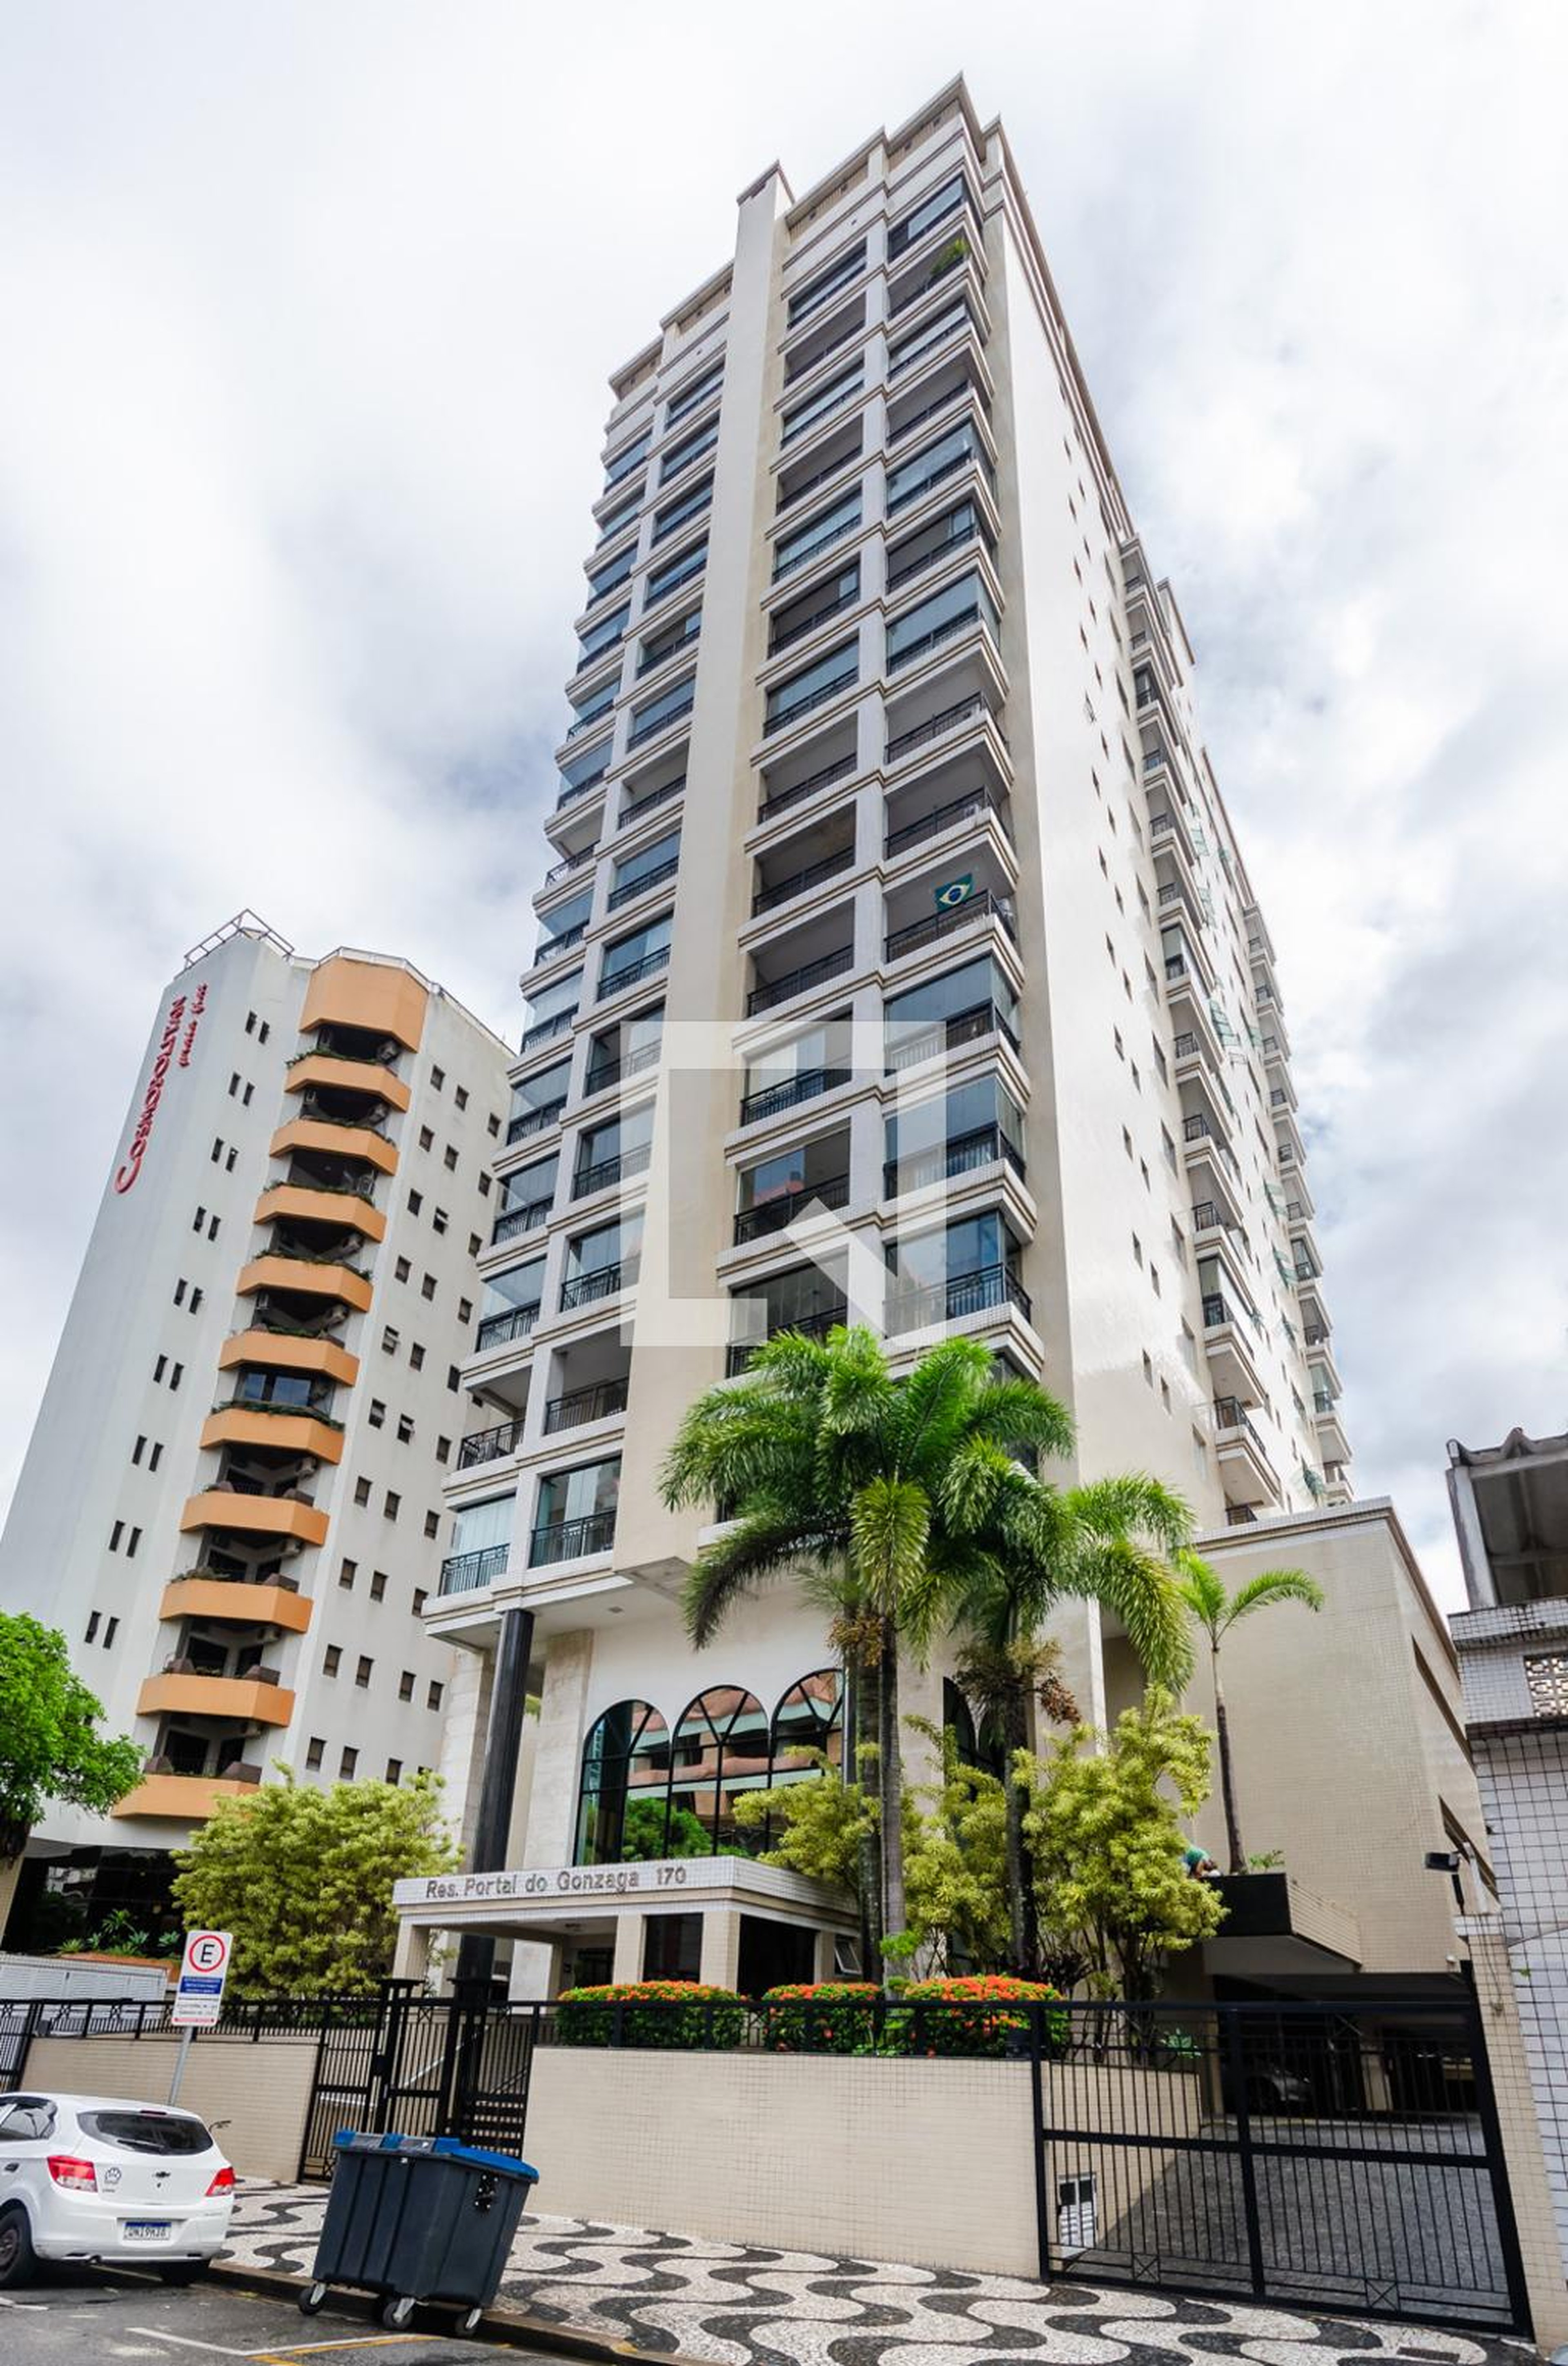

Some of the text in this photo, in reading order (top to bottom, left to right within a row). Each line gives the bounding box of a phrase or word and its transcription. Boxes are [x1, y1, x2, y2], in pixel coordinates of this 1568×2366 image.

[426, 1866, 686, 1898] Res. Portal do Gonzaga 170
[200, 1944, 215, 1963] E
